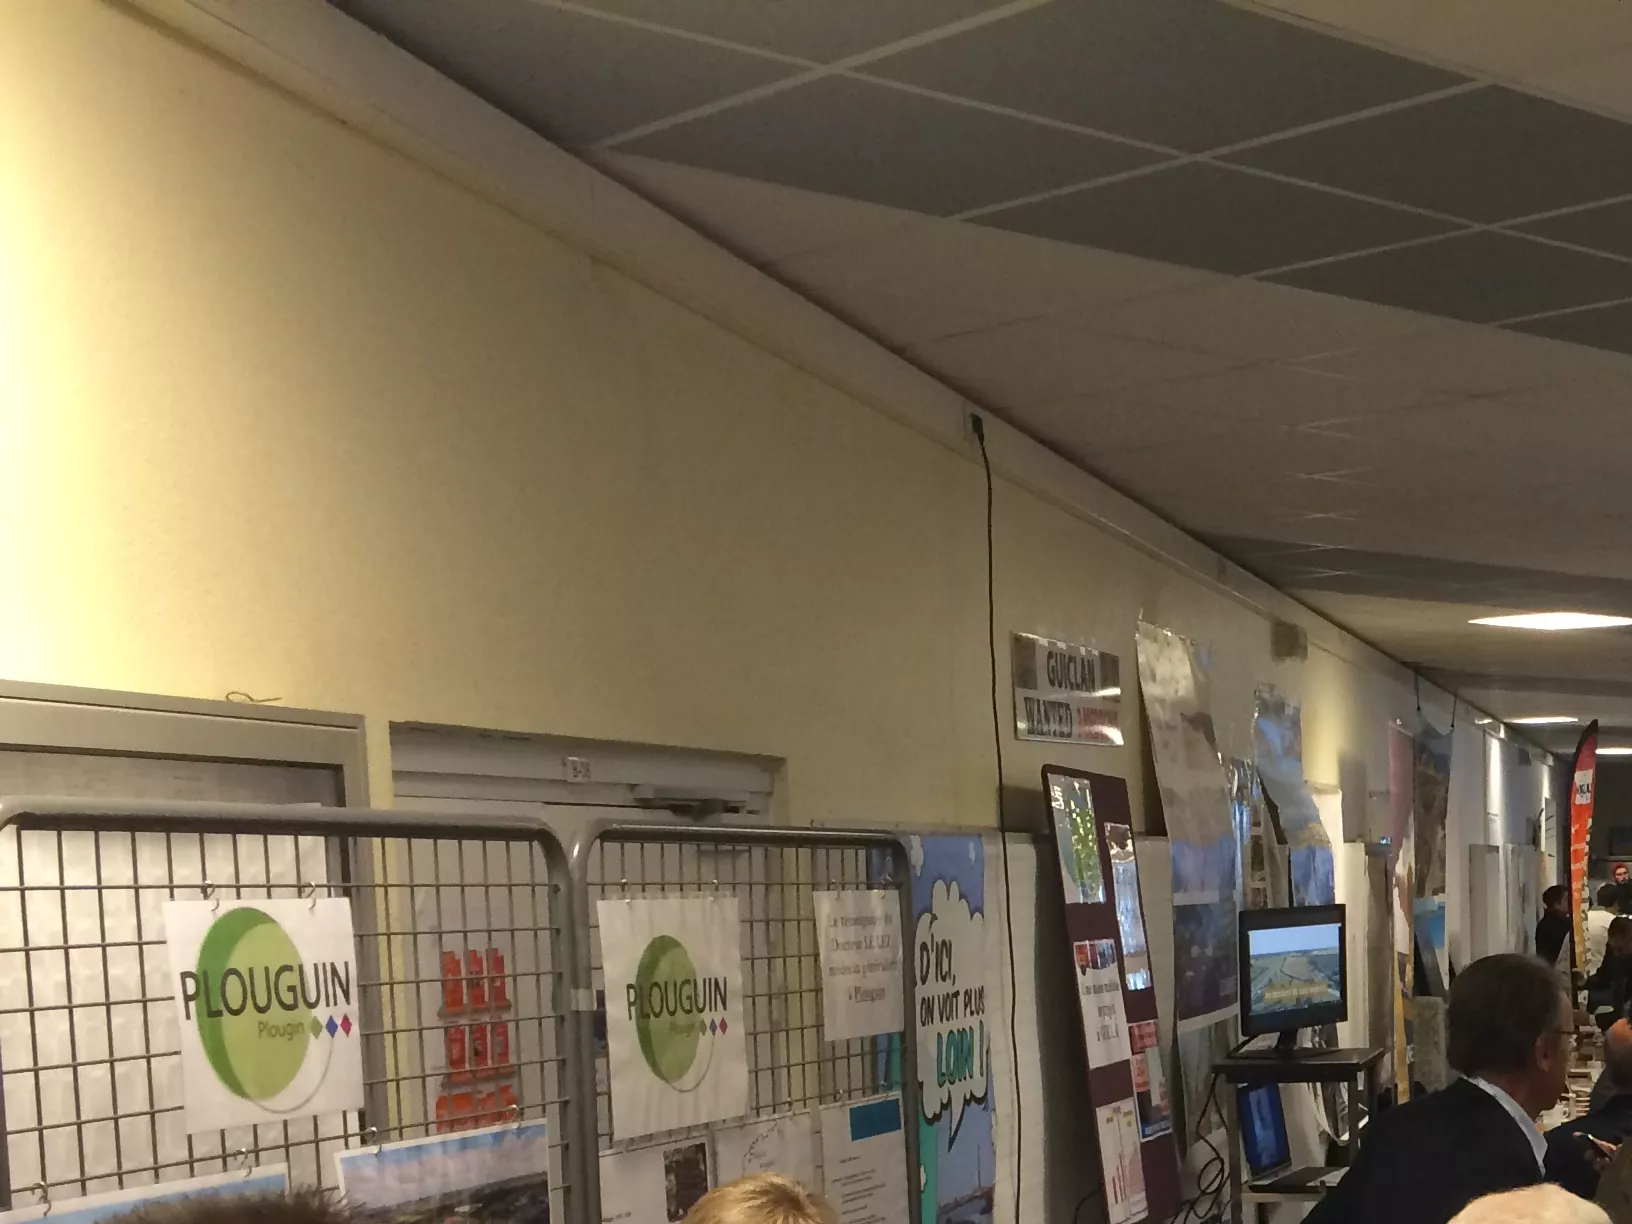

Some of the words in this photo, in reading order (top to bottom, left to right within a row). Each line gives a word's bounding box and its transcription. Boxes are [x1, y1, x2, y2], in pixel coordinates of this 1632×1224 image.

[1046, 650, 1096, 694] GUICLAN
[1023, 696, 1073, 739] WANTED
[919, 932, 957, 987] D'ICI,
[180, 961, 351, 1021] PLOUGUIN
[625, 976, 728, 1021] PLOUGUIN
[919, 996, 935, 1027] ON
[937, 990, 960, 1024] VOIT
[963, 985, 985, 1018] PLUS
[258, 1019, 305, 1041] Plougin
[936, 1025, 975, 1089] LOIN
